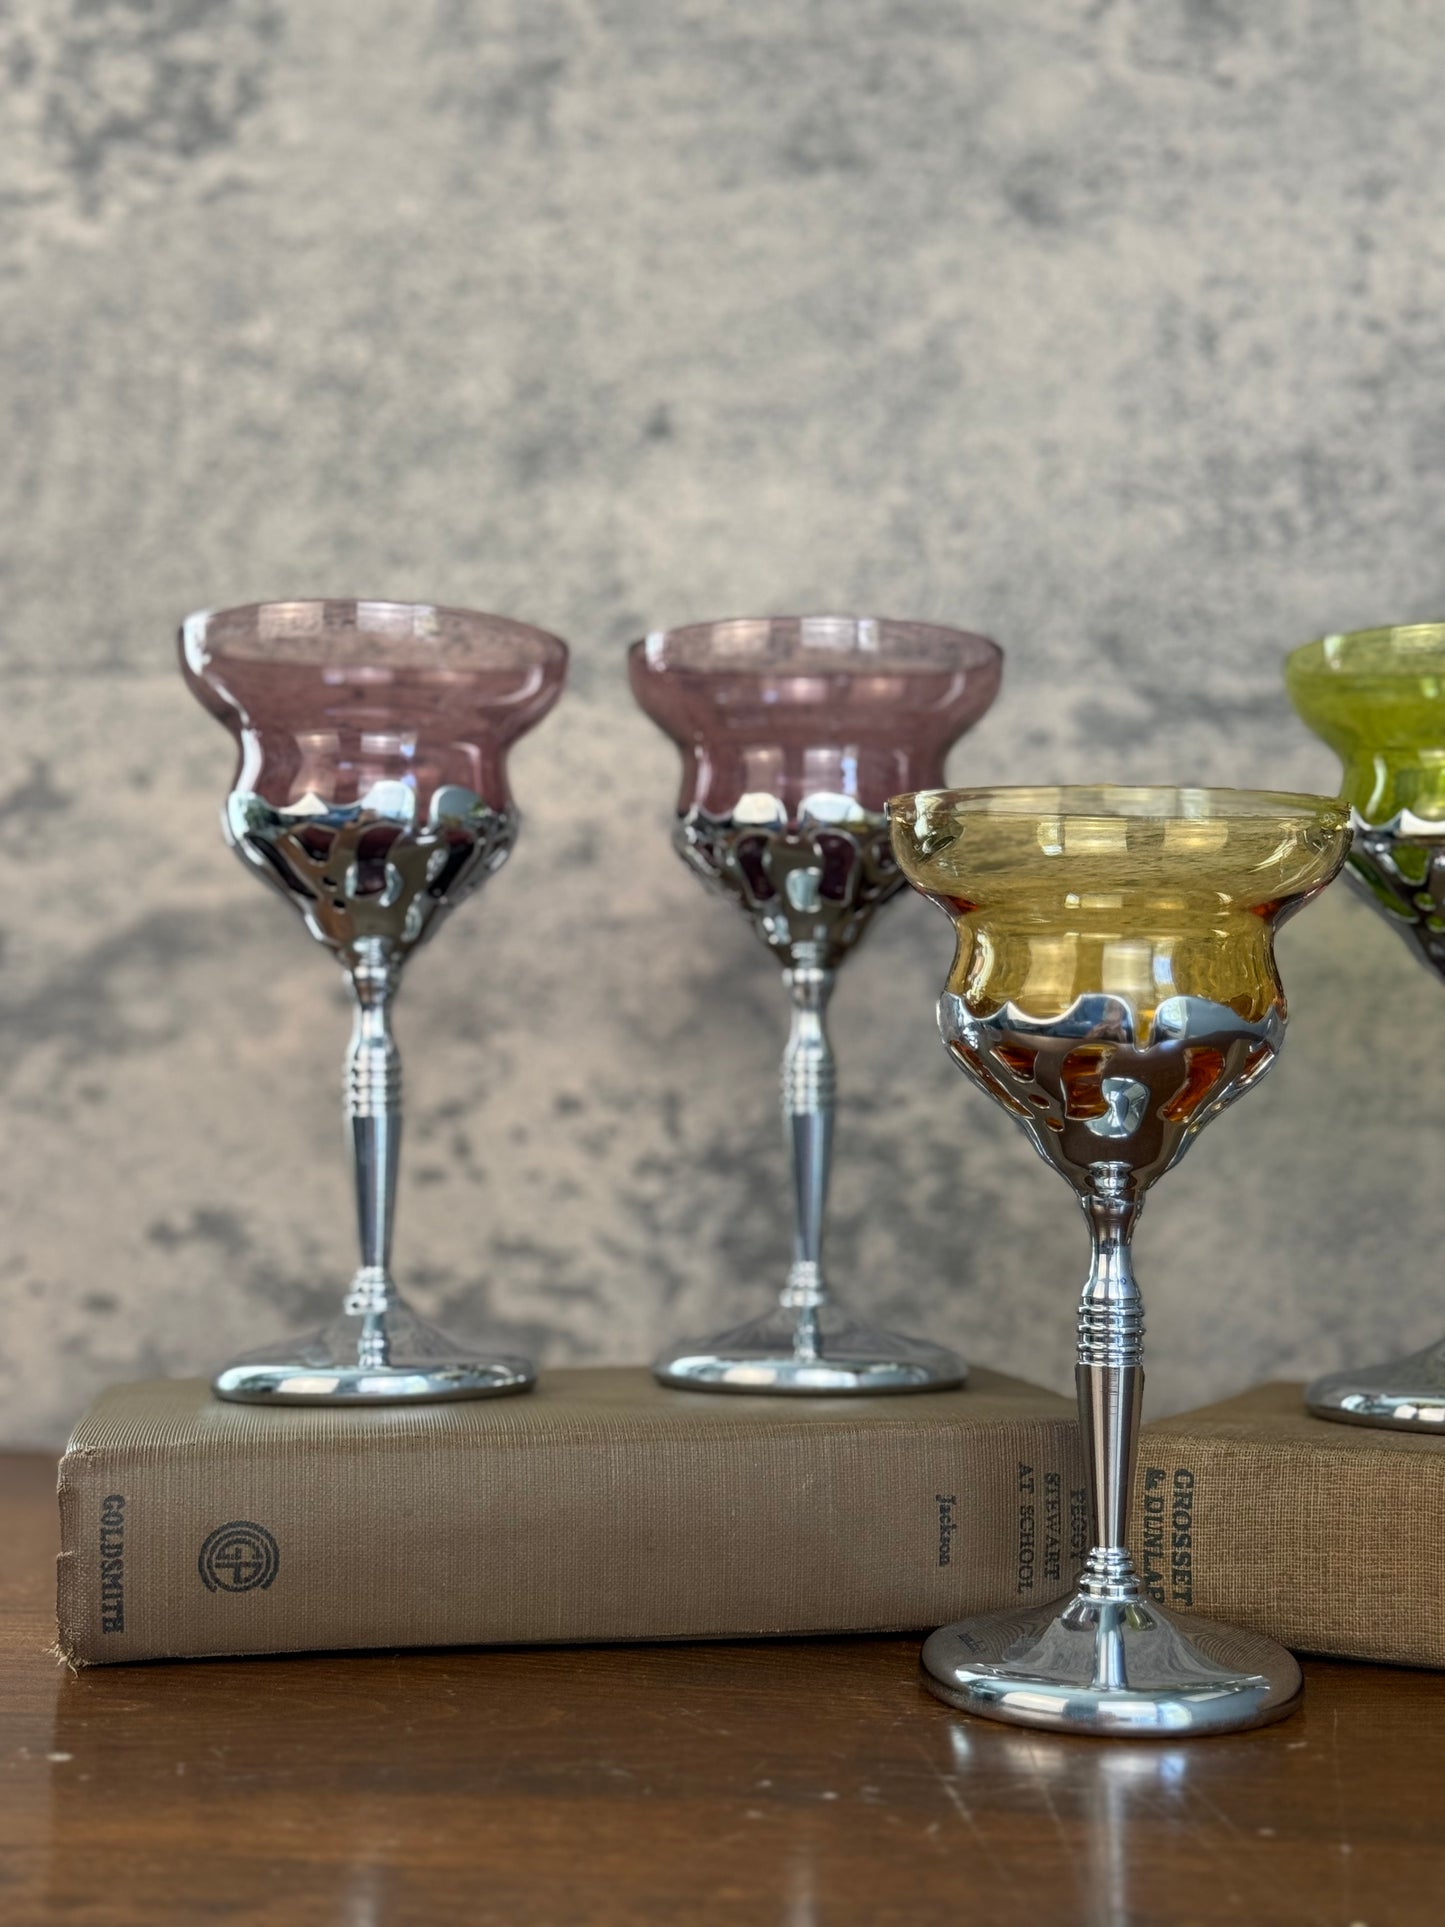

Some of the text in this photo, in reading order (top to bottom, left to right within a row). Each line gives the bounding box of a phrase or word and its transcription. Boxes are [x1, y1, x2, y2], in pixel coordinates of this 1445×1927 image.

[100, 1494, 126, 1635] GOLDSMITH
[935, 1494, 958, 1567] Jackson
[1017, 1461, 1035, 1594] AT SCHOOL
[1043, 1472, 1061, 1580] STEWART
[1070, 1488, 1089, 1560] PEGGY
[1143, 1467, 1167, 1604] & DUNLAP
[1171, 1468, 1194, 1606] GROSSET
